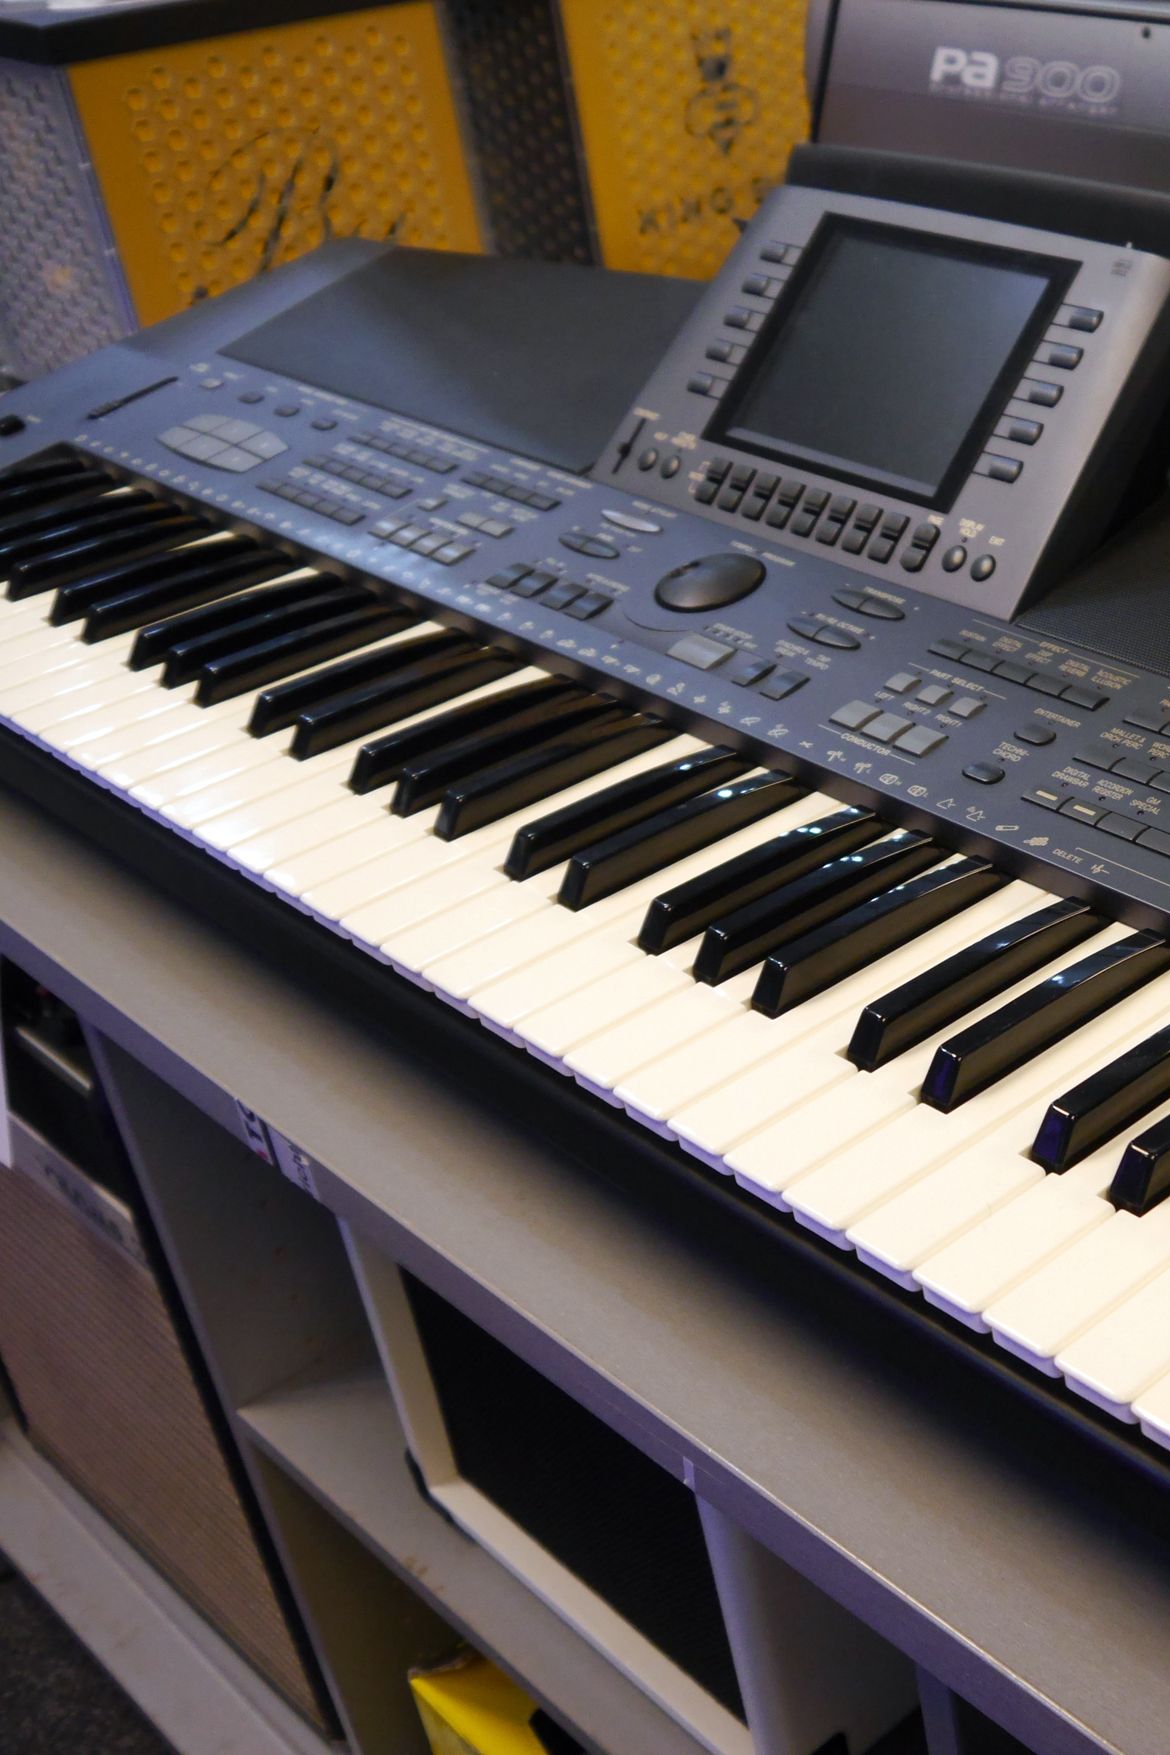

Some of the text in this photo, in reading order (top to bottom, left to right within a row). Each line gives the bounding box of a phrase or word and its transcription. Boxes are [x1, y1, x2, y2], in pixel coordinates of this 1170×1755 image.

[928, 669, 985, 692] PART SELECT
[1033, 707, 1082, 728] ENTERTAINER
[1111, 727, 1140, 740] MALLET
[840, 732, 892, 756] CONDUCTOR
[1148, 747, 1170, 759] PERC
[1063, 766, 1091, 781] DIGITAL
[1129, 799, 1161, 816] SPECIAL
[1052, 848, 1084, 865] DELETE
